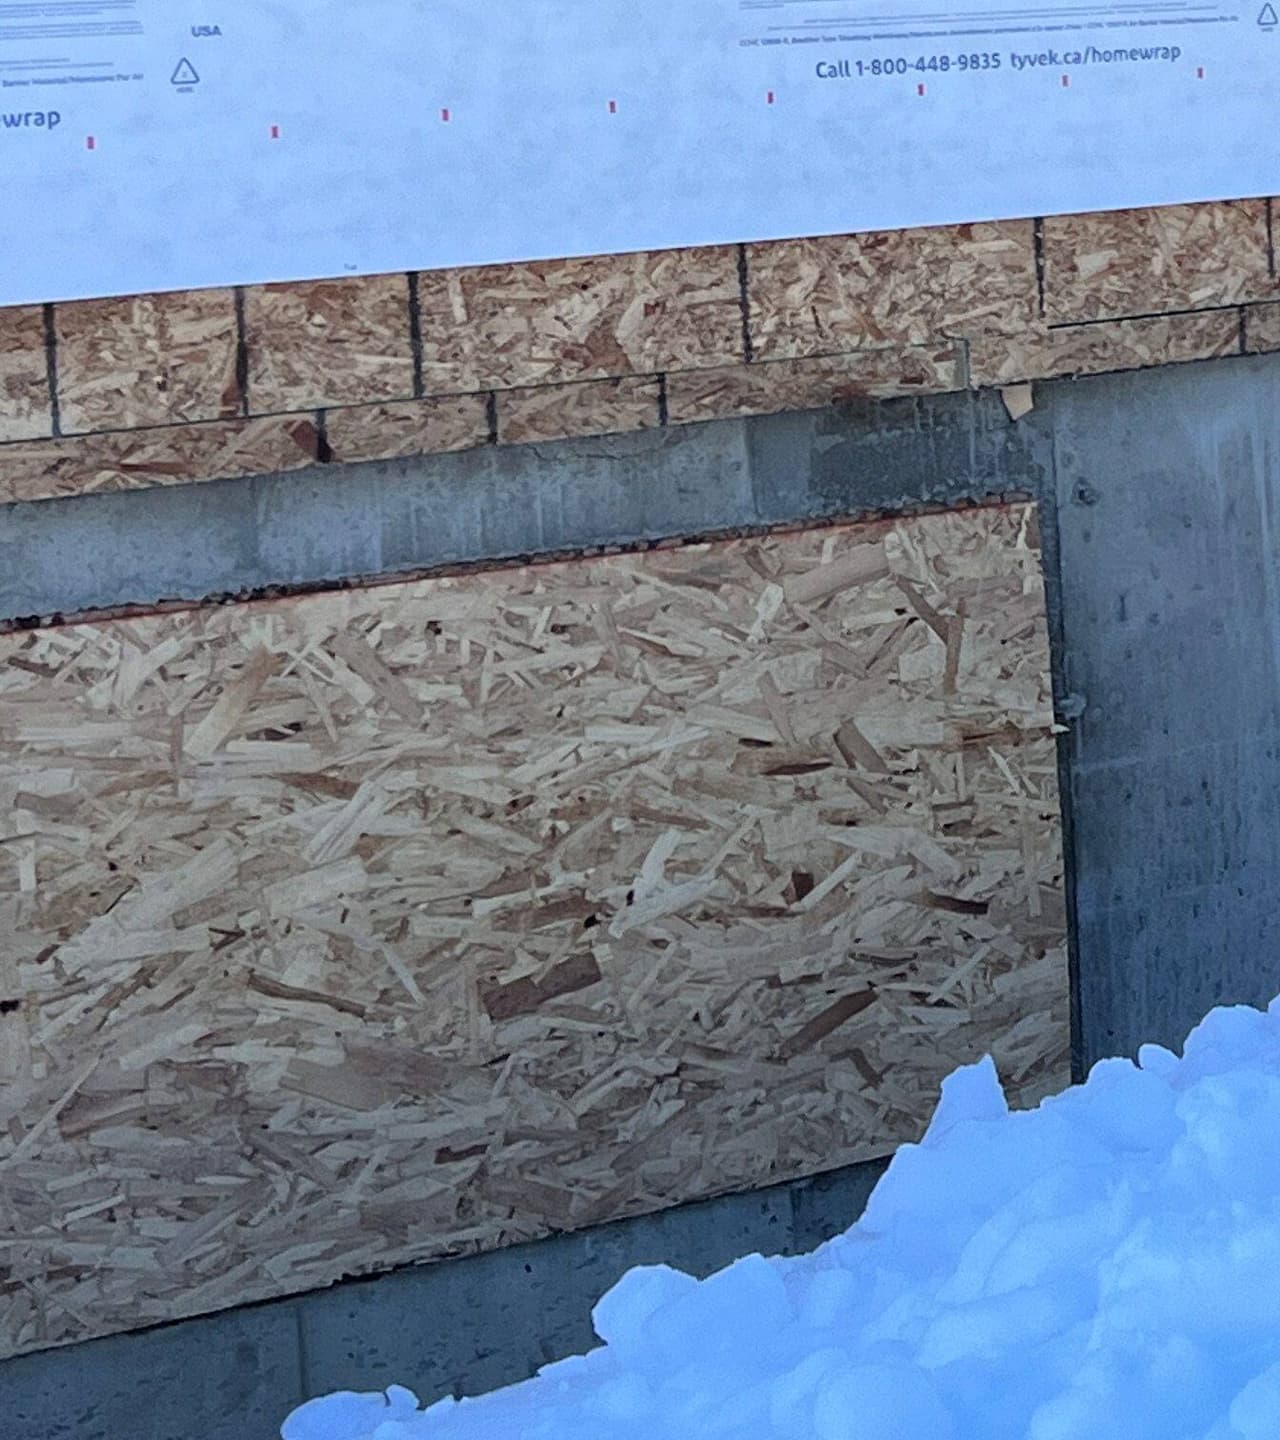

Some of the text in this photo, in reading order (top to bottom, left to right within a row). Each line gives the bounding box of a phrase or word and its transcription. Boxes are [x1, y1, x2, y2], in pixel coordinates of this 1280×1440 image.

[191, 25, 222, 37] USA
[816, 46, 1181, 78] Call 1-800-448-9835 tyvek.ca/homewrap
